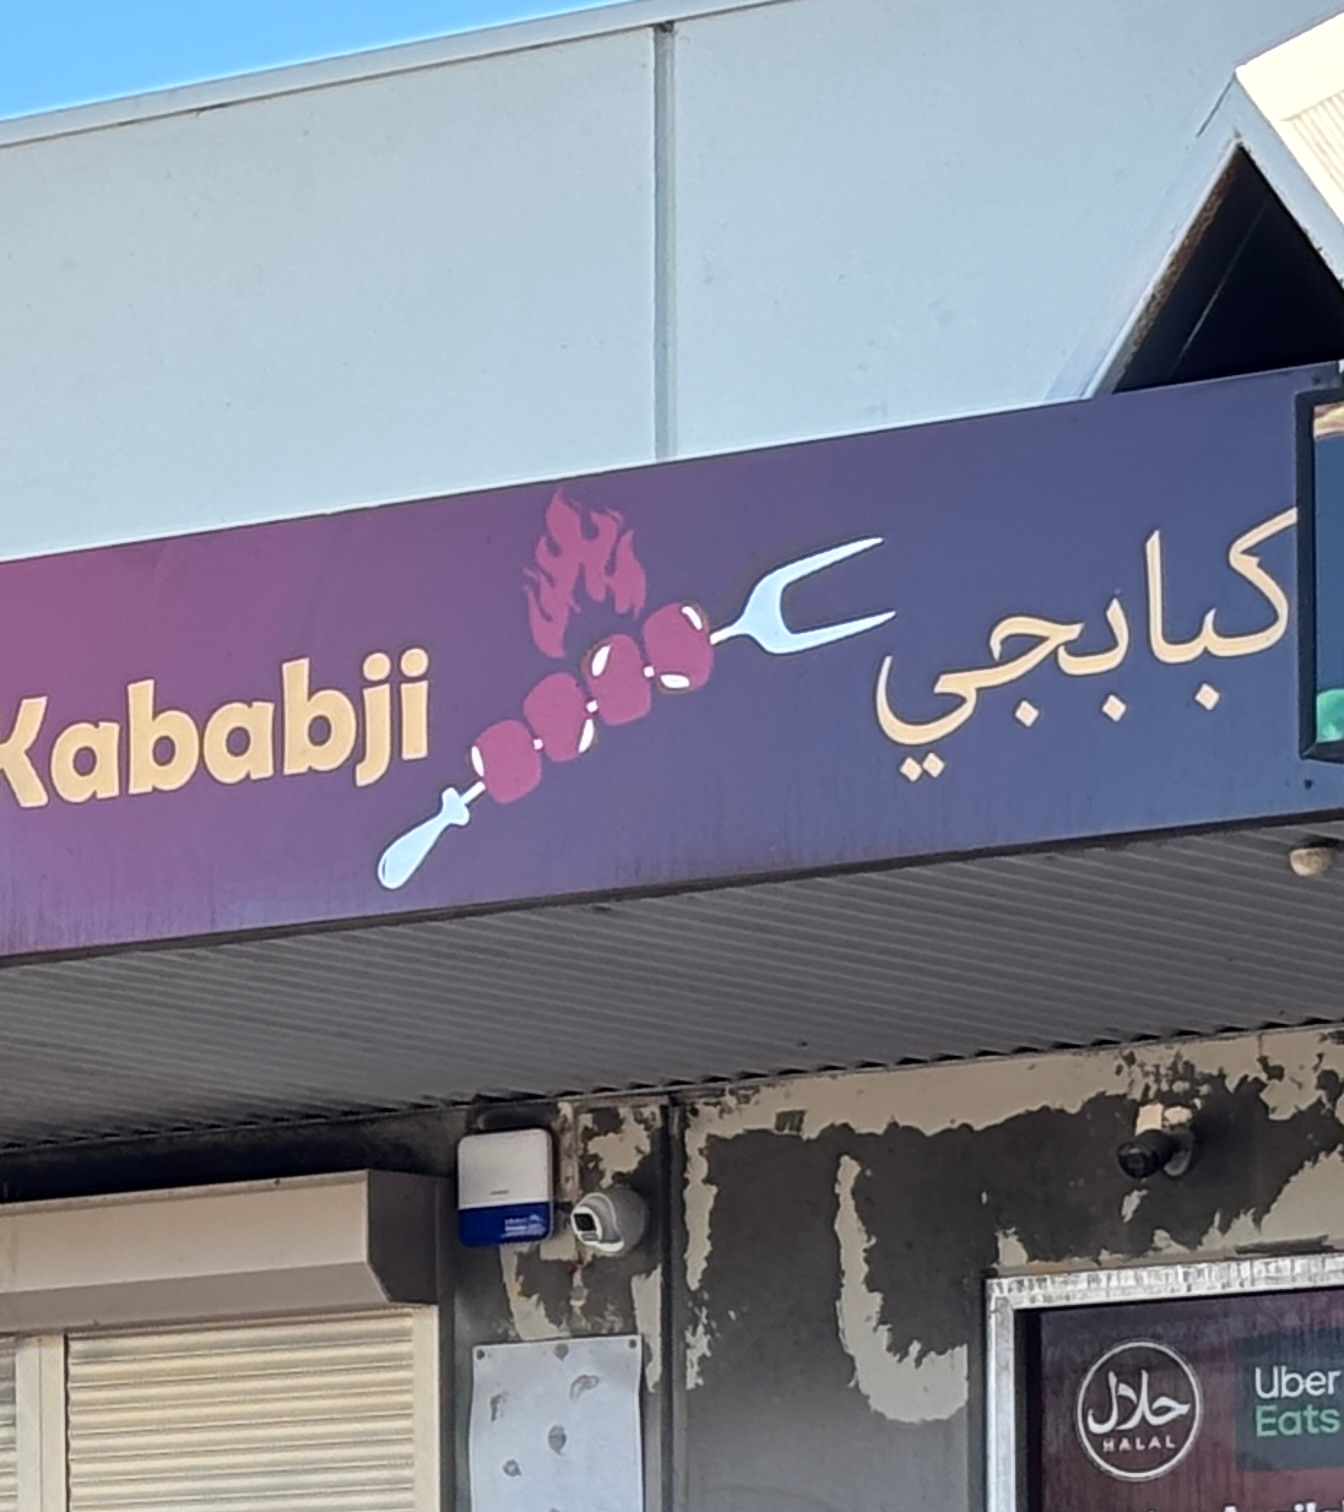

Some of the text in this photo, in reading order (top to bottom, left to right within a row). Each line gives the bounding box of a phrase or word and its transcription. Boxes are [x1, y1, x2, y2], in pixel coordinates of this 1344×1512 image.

[874, 506, 1298, 782] كبابجي
[1254, 1364, 1342, 1400] Uber
[1087, 1368, 1192, 1436] حلال
[1255, 1403, 1341, 1439] Eats
[1103, 1435, 1177, 1453] HALAL
